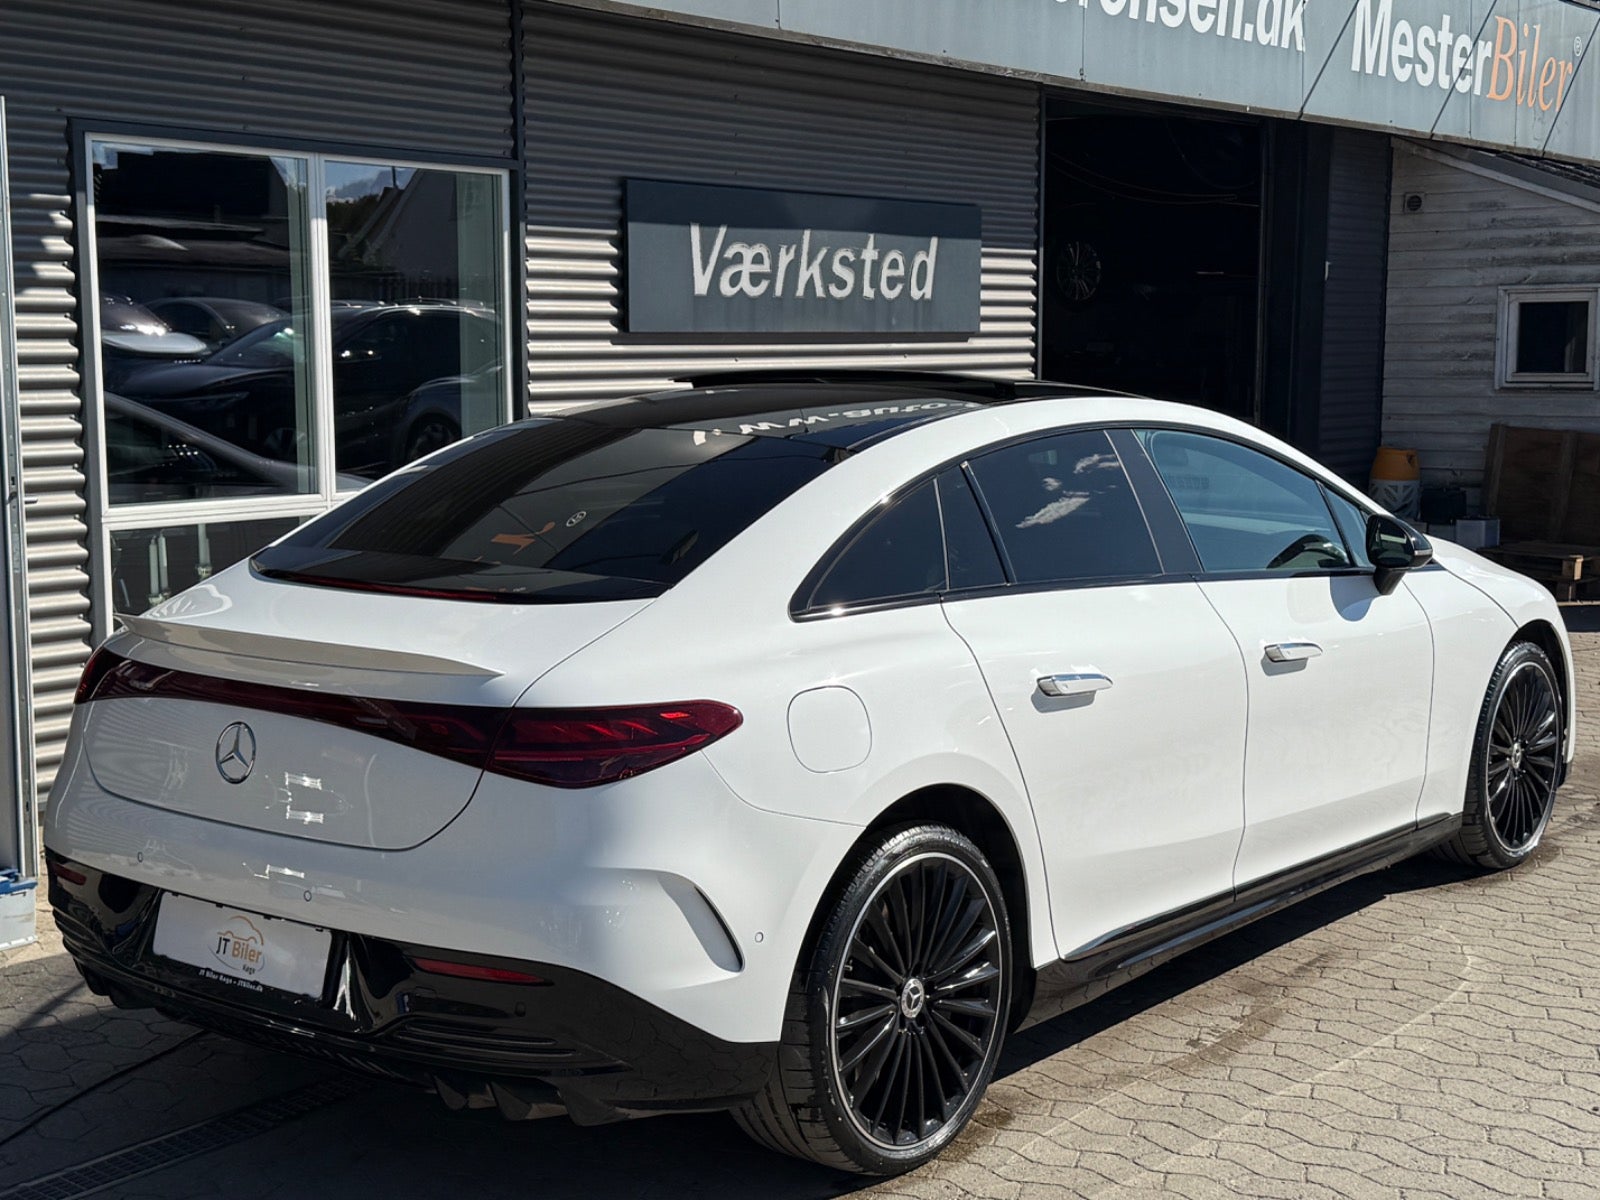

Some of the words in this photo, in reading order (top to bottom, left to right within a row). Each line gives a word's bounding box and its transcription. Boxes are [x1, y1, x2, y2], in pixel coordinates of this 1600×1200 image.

[689, 222, 940, 301] Værksted
[215, 936, 231, 954] JT
[232, 941, 262, 963] Biler
